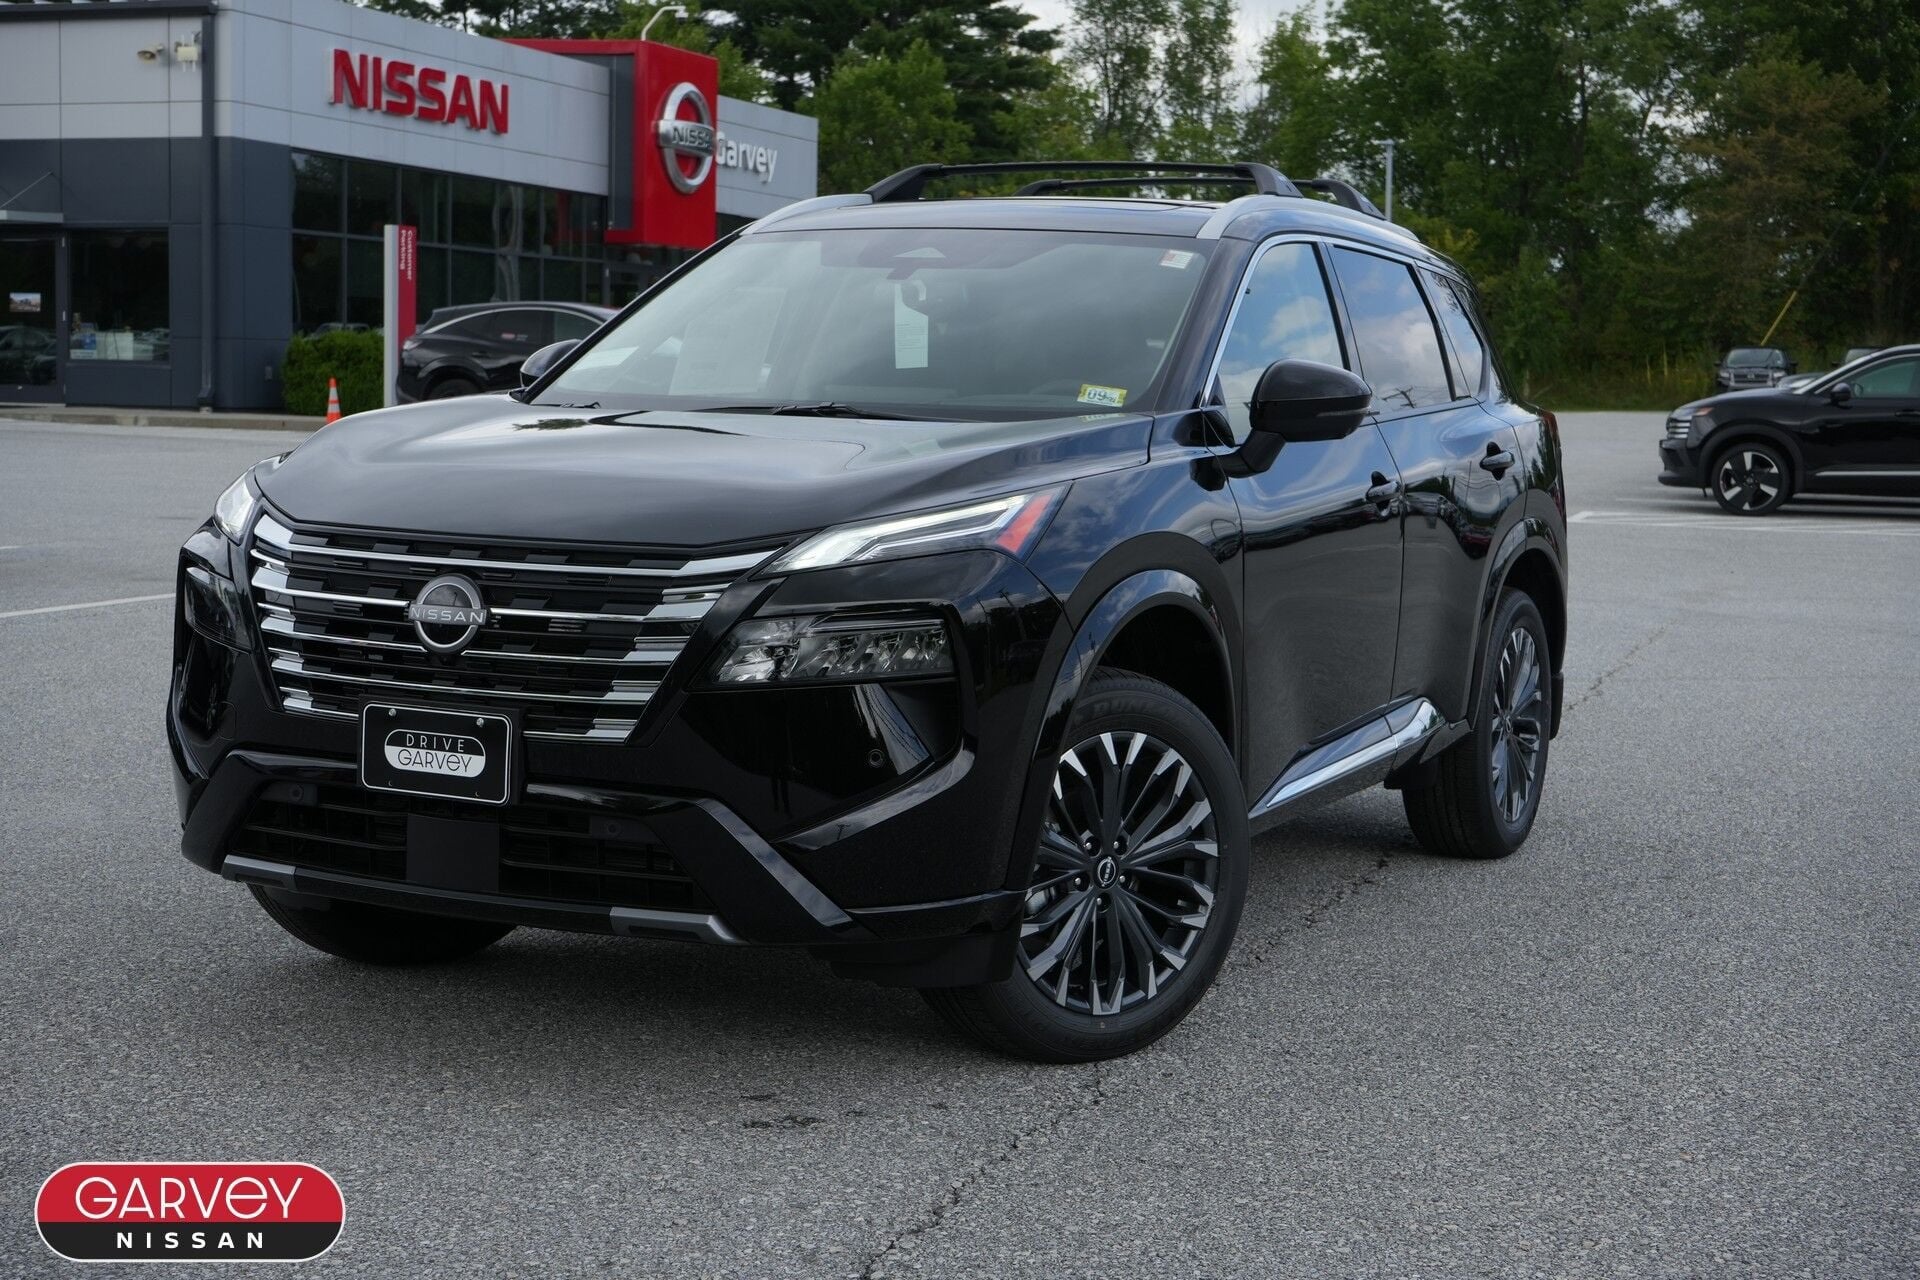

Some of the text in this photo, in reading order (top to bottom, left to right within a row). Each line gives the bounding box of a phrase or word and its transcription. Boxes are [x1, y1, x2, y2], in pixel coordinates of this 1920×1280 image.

[333, 48, 509, 134] NISSAN
[672, 127, 712, 149] NISS
[715, 131, 778, 183] Garvey
[410, 606, 485, 624] NISSAN
[406, 733, 465, 753] DRIVE
